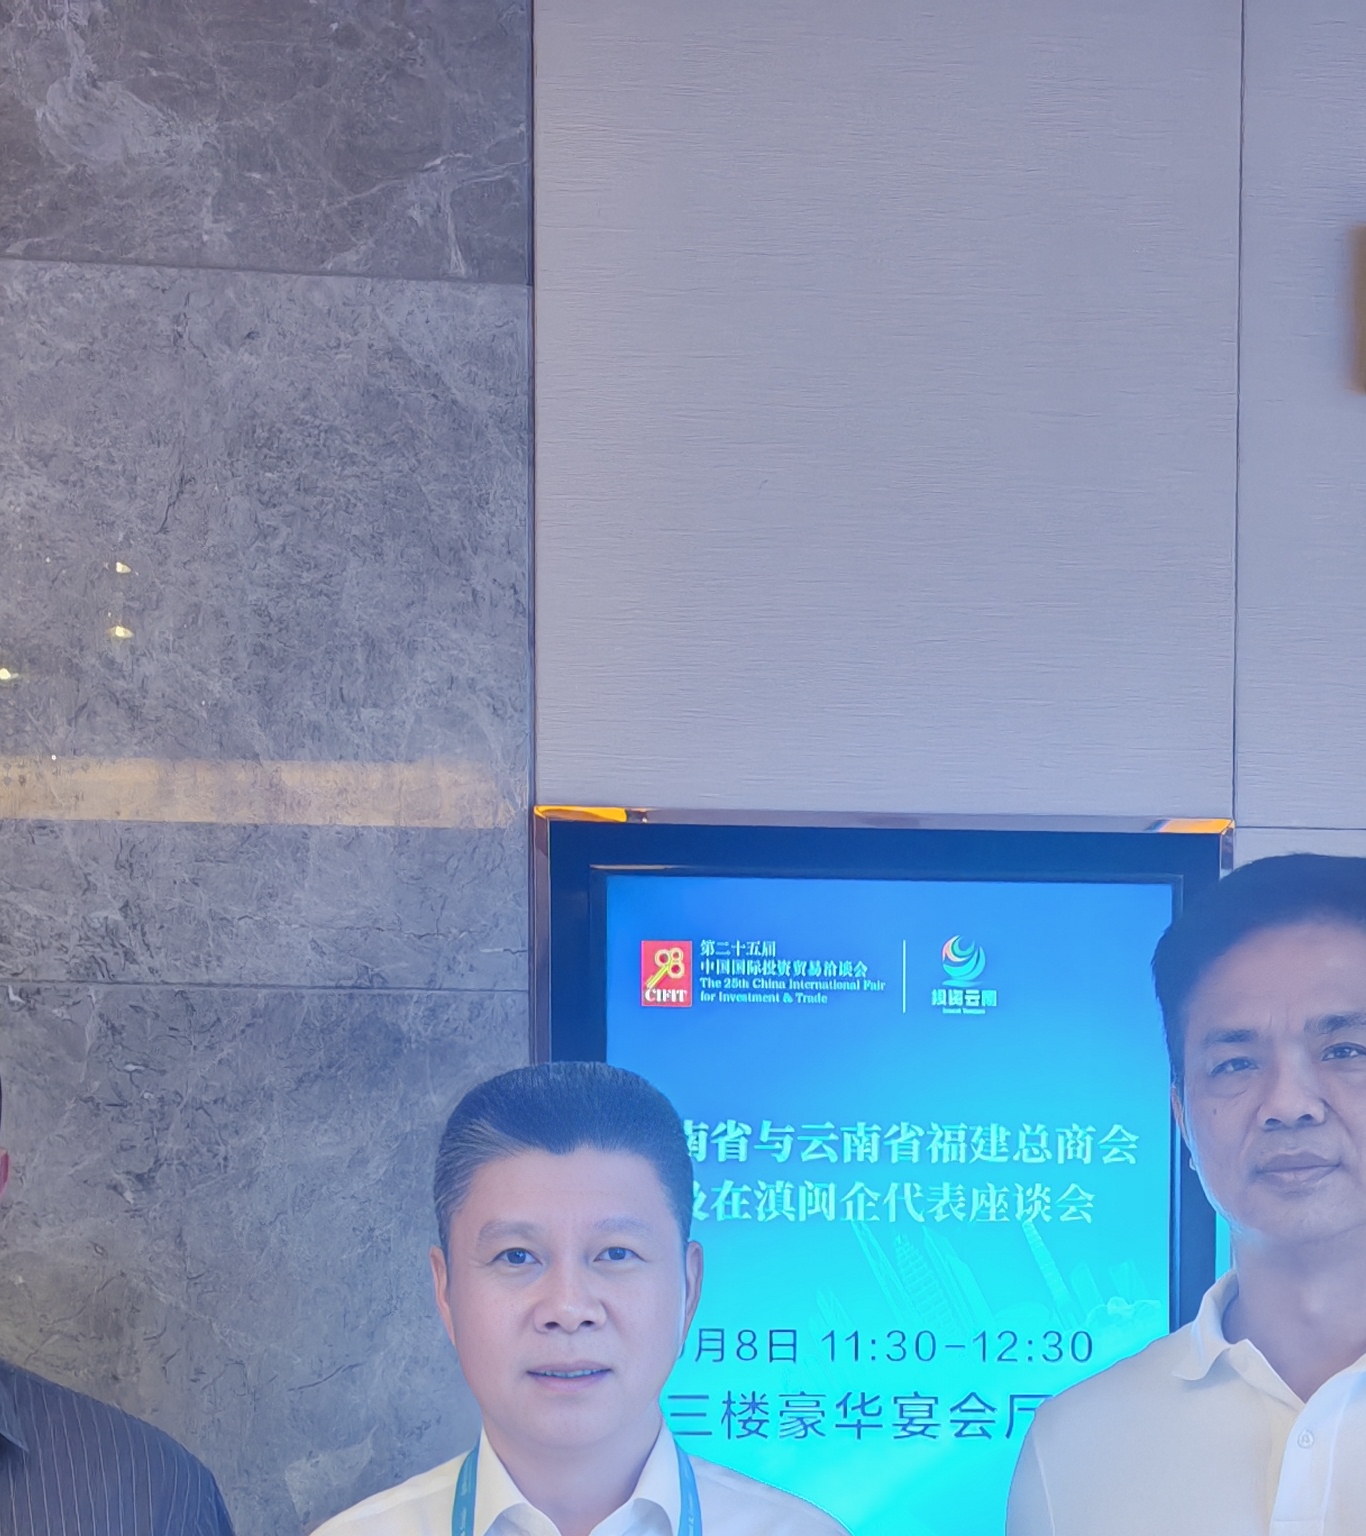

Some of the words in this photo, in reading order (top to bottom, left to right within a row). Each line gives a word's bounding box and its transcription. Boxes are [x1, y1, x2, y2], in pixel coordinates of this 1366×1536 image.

[700, 939, 776, 957] 第二十五届
[699, 977, 722, 989] The
[723, 977, 750, 989] 25th
[752, 977, 787, 990] China
[789, 978, 861, 991] International
[863, 979, 886, 991] Fair
[700, 990, 716, 1003] for
[718, 990, 780, 1003] Investment
[795, 992, 828, 1004] Trade
[678, 1327, 798, 1363] 月8日
